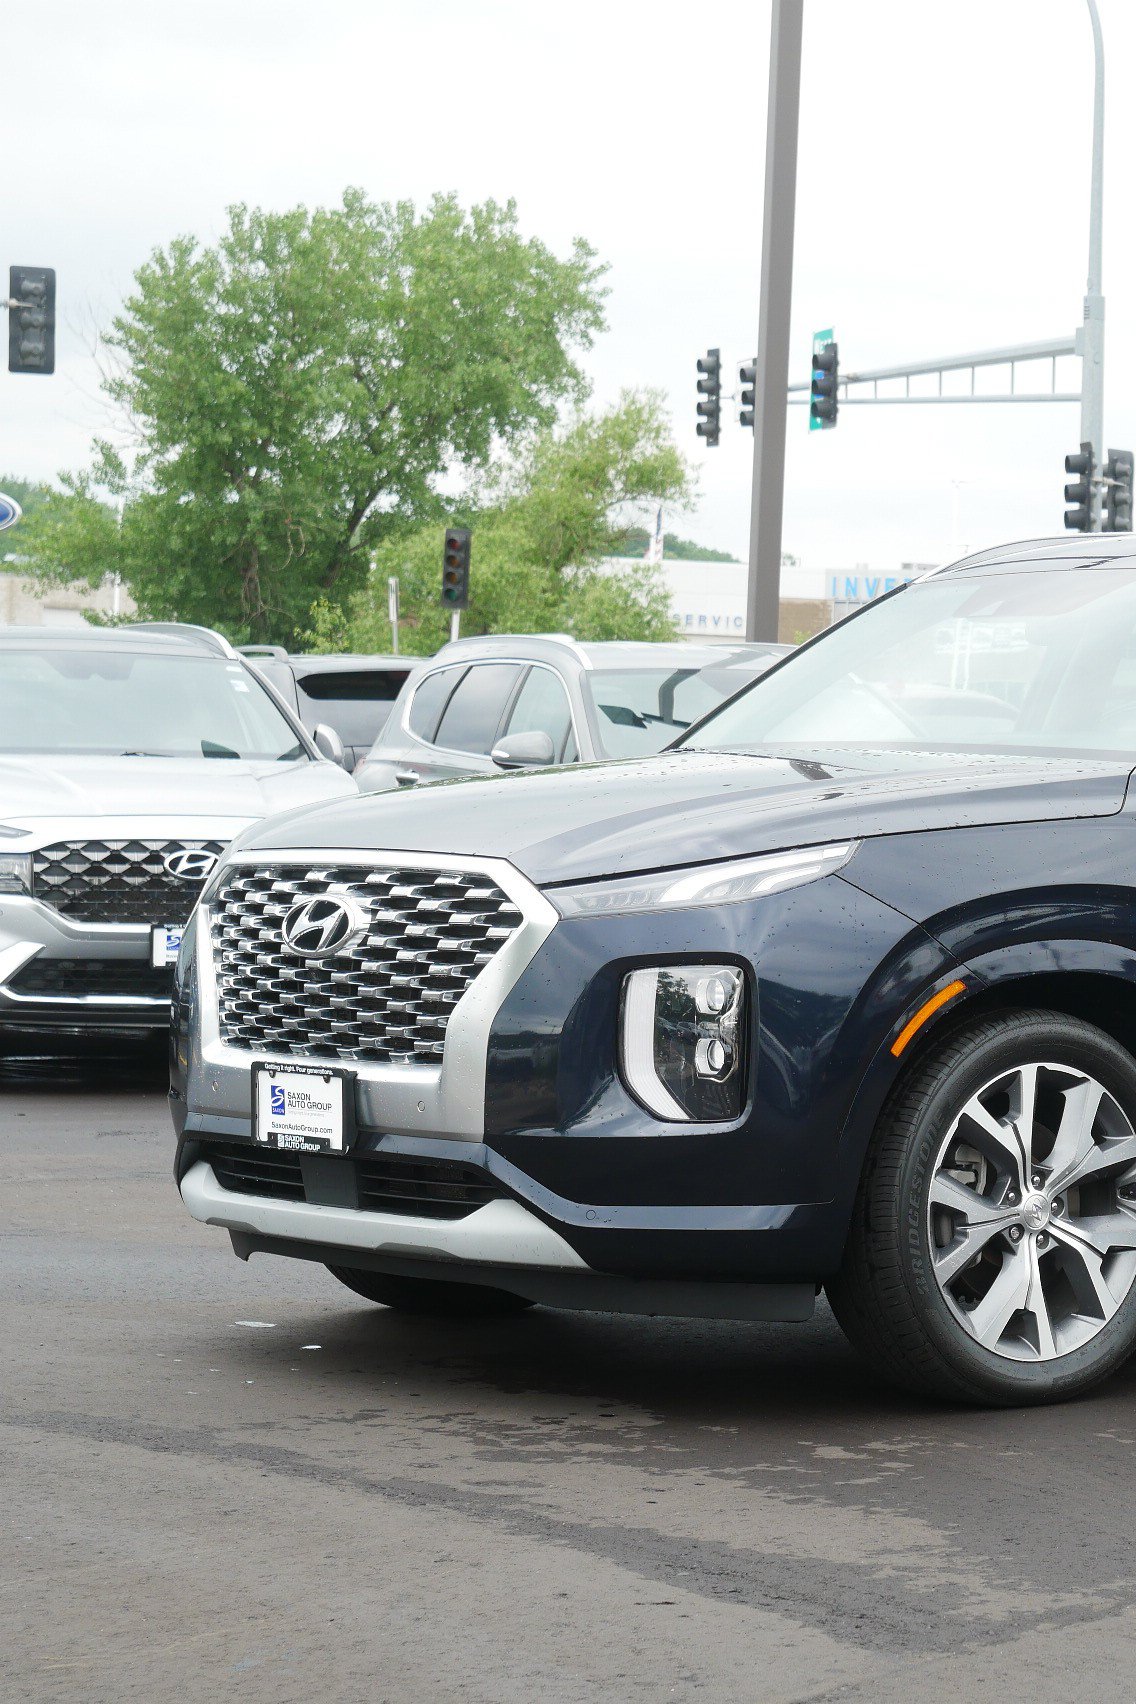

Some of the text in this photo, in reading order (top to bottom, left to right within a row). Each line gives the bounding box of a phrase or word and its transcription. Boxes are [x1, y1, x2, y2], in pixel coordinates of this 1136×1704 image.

[831, 576, 912, 598] INVE
[672, 612, 744, 629] SERVIC
[287, 1091, 311, 1101] SAXON
[287, 1100, 333, 1111] AUTO GROUP
[271, 1121, 333, 1135] SaxonAutoGroup.com
[285, 1134, 305, 1143] SAXON
[285, 1142, 321, 1151] AUTO GROUP
